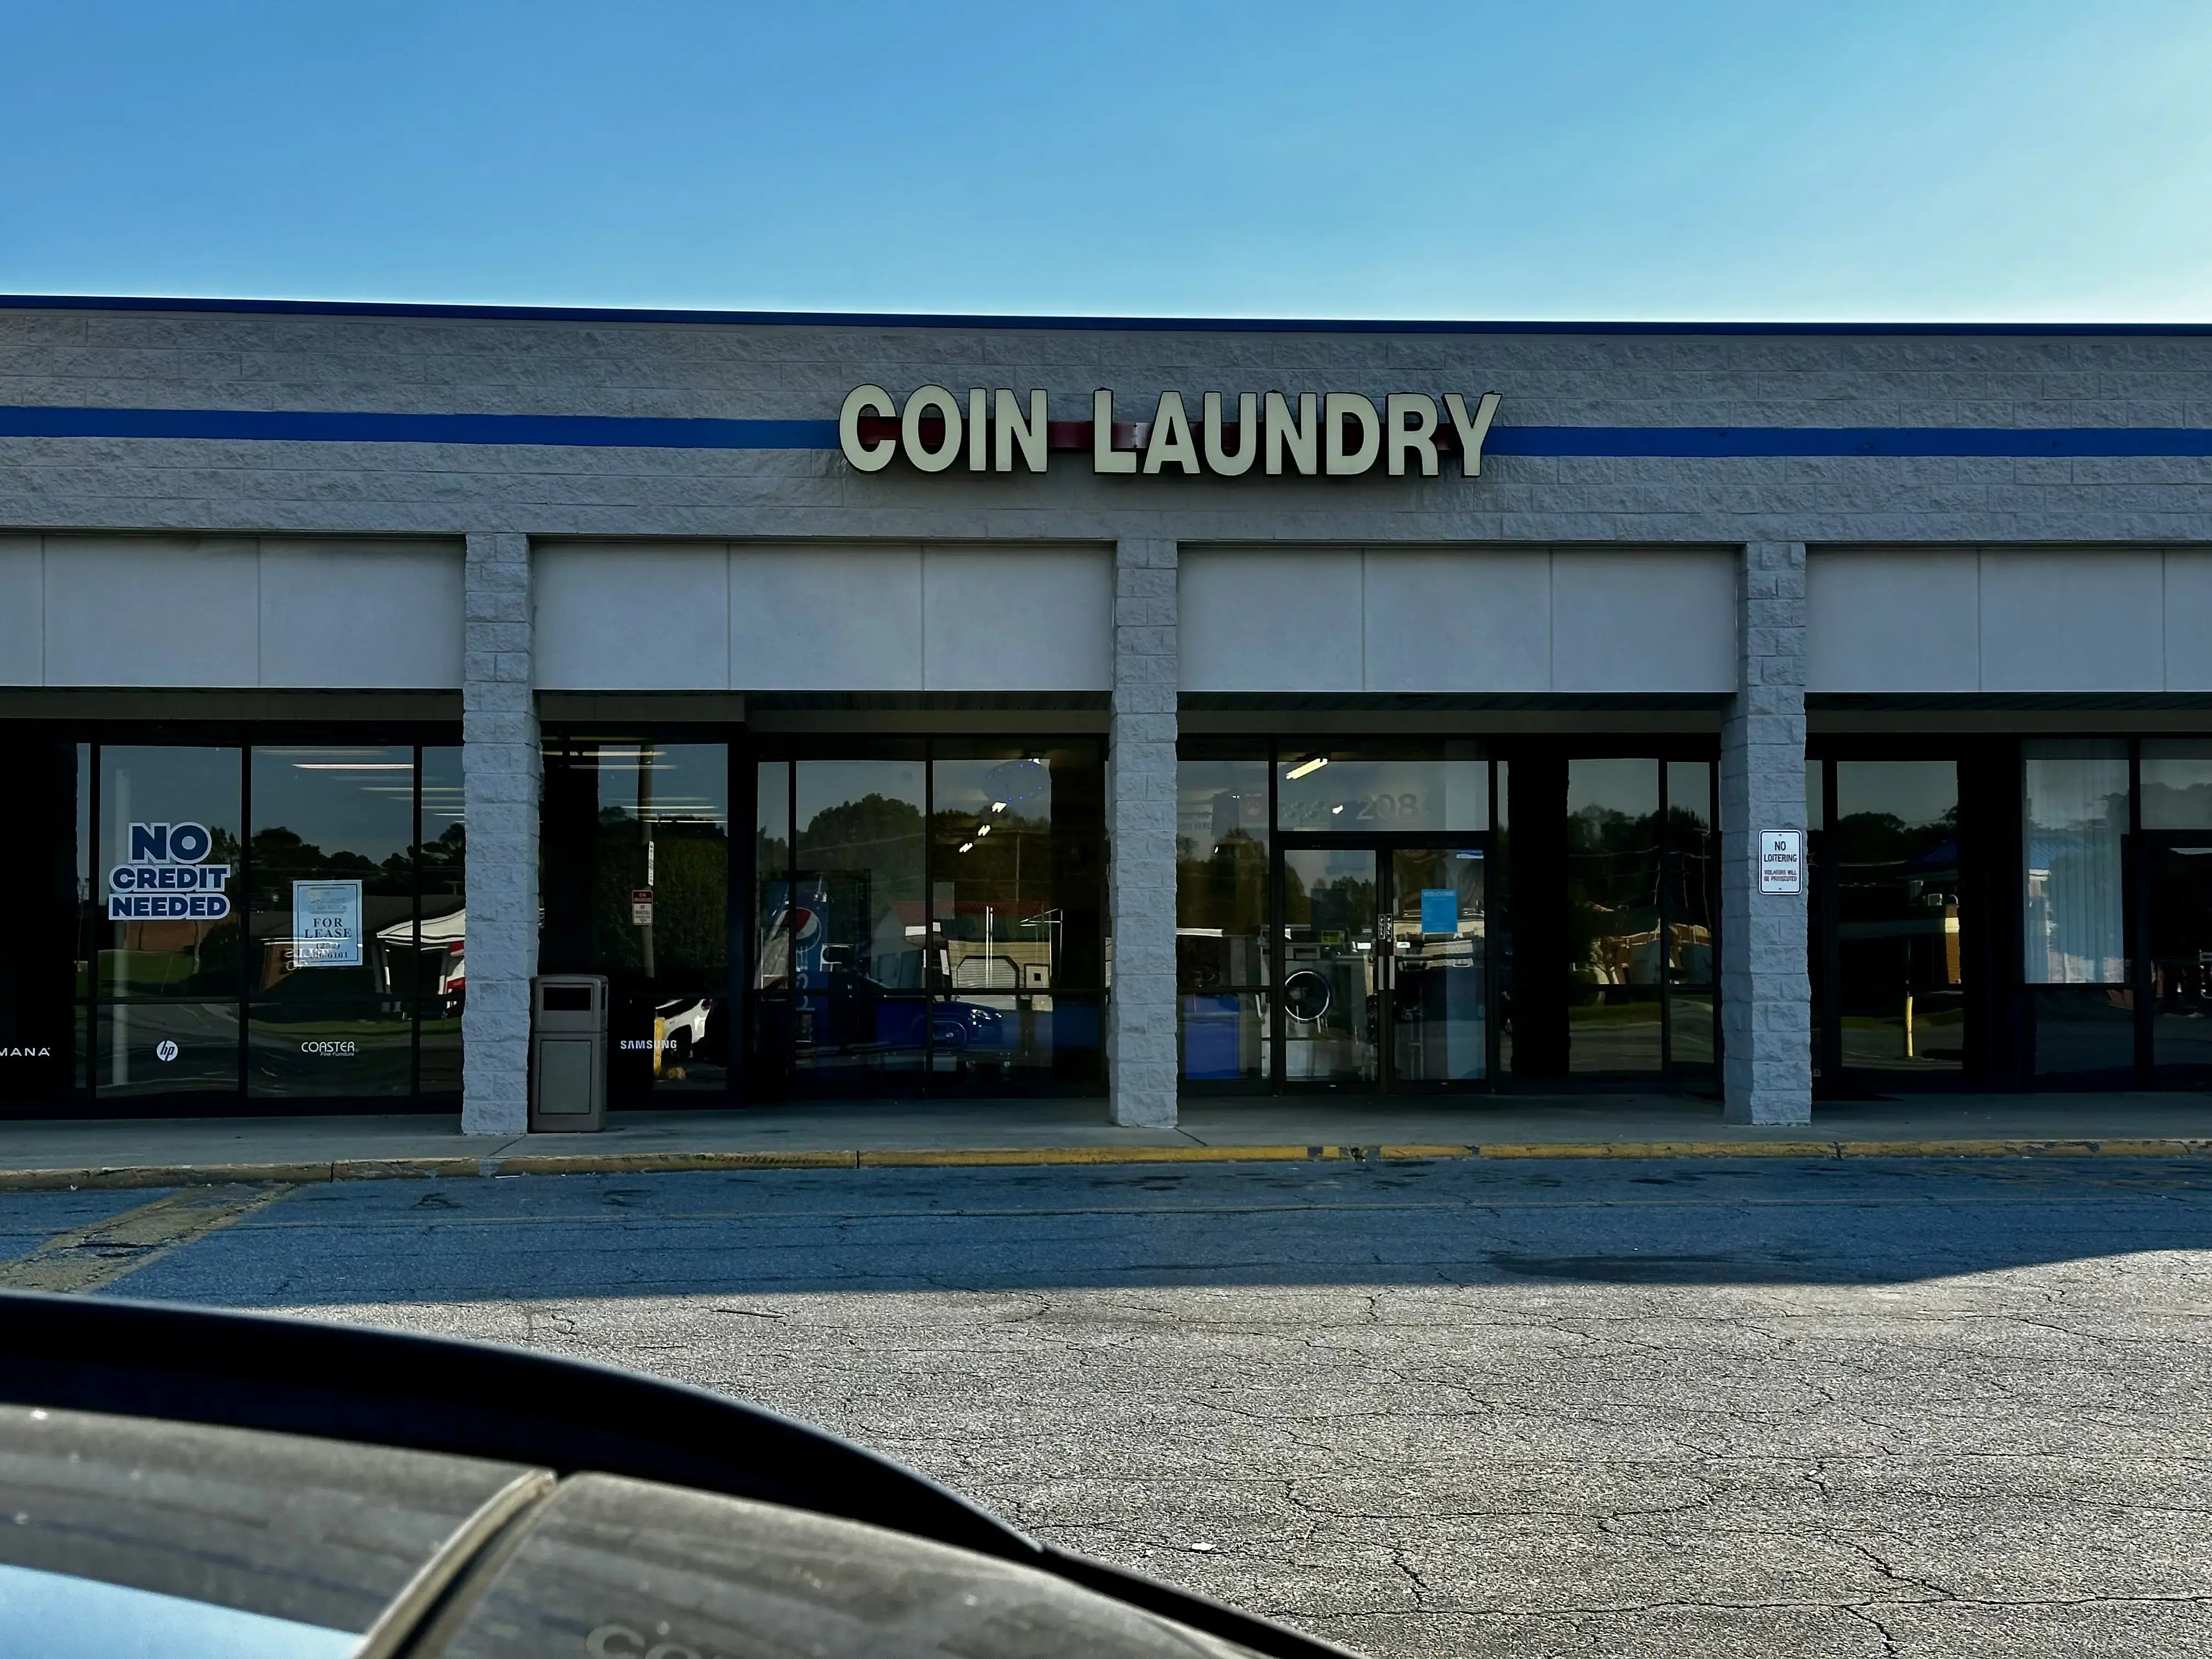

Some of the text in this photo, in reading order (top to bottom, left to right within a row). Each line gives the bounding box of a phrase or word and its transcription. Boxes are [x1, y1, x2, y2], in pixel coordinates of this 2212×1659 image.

[839, 383, 1502, 477] COIN LAUNDRY
[132, 825, 208, 860] NO
[1774, 841, 1786, 851] NO
[112, 867, 227, 889] CREDIT
[112, 896, 227, 917] NEEDED
[313, 918, 342, 927] FOR
[304, 928, 352, 938] LEASE
[301, 1041, 355, 1052] COASTER
[620, 1040, 677, 1049] SAMSUNG
